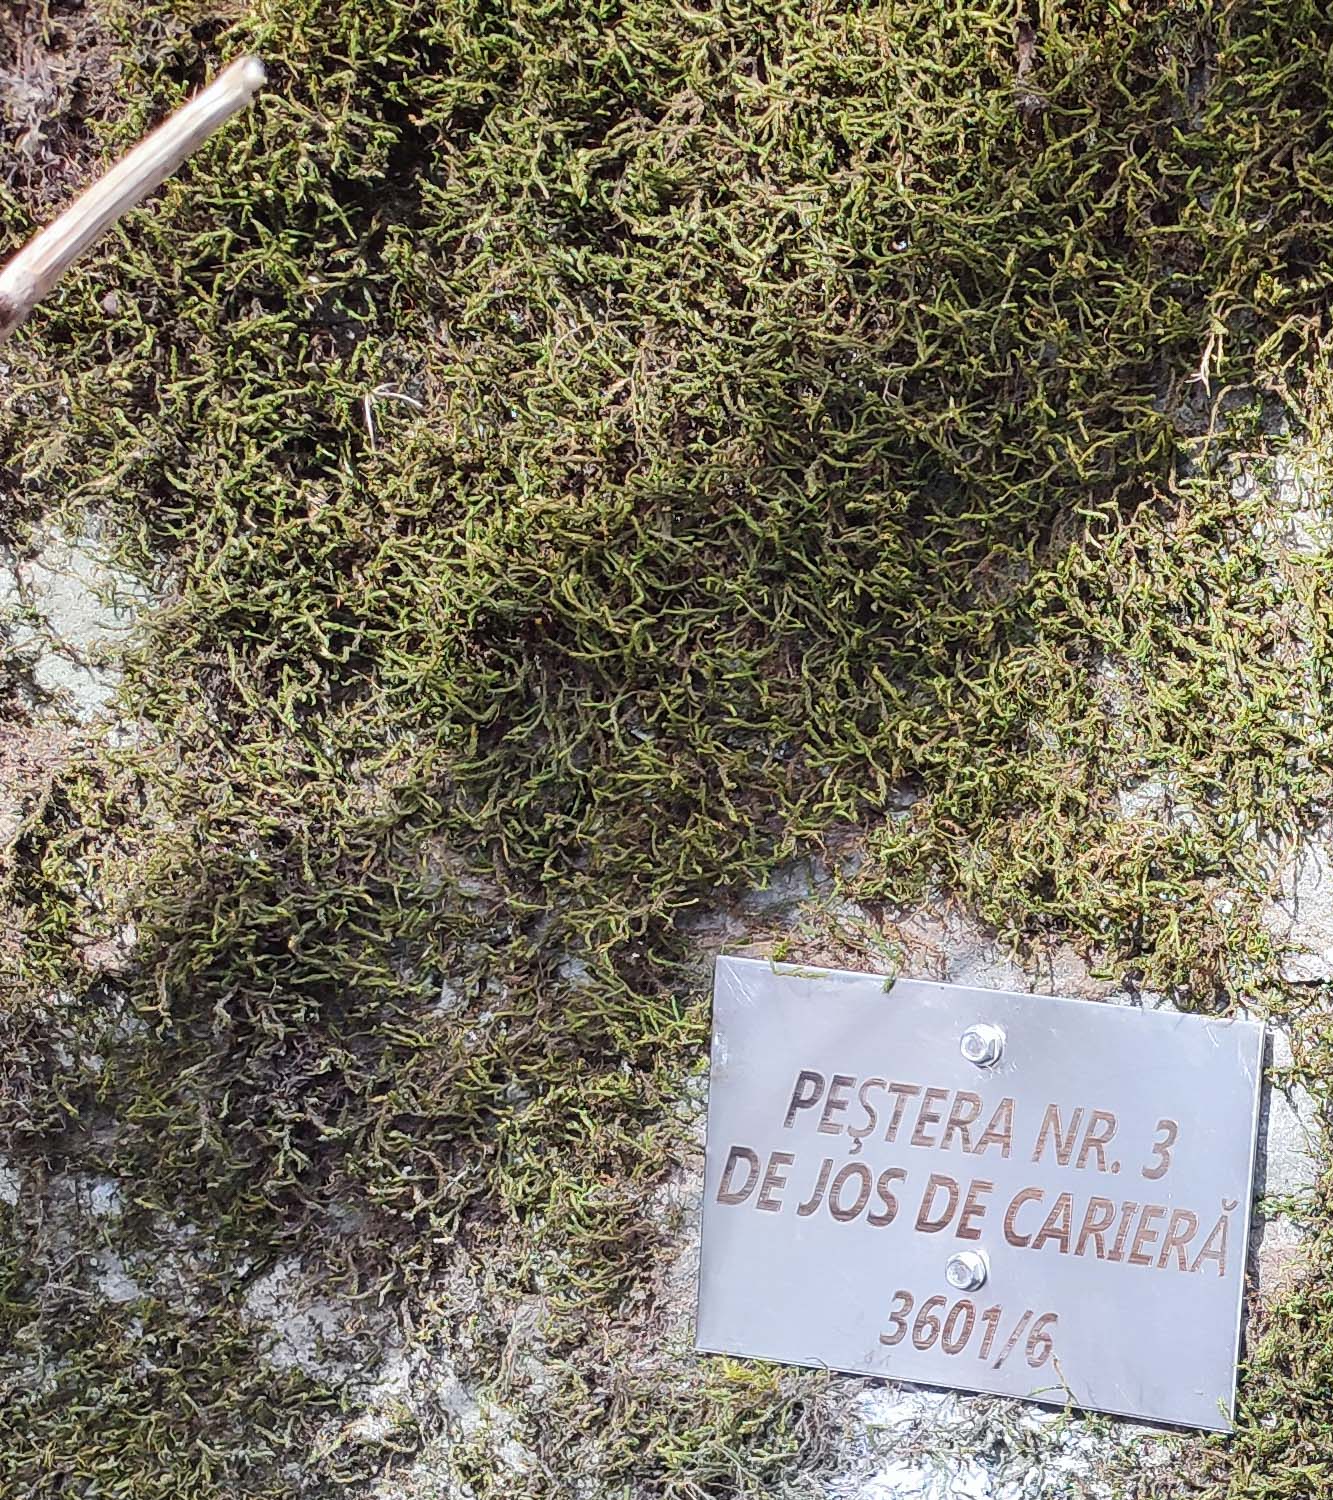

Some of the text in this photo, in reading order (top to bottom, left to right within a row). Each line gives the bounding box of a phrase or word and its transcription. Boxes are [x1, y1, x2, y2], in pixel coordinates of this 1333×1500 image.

[1031, 1103, 1121, 1174] NR.
[1141, 1119, 1179, 1180] 3
[715, 1145, 1239, 1278] DE JOS DE CARIERĂ
[878, 1289, 1060, 1371] 3601/6
